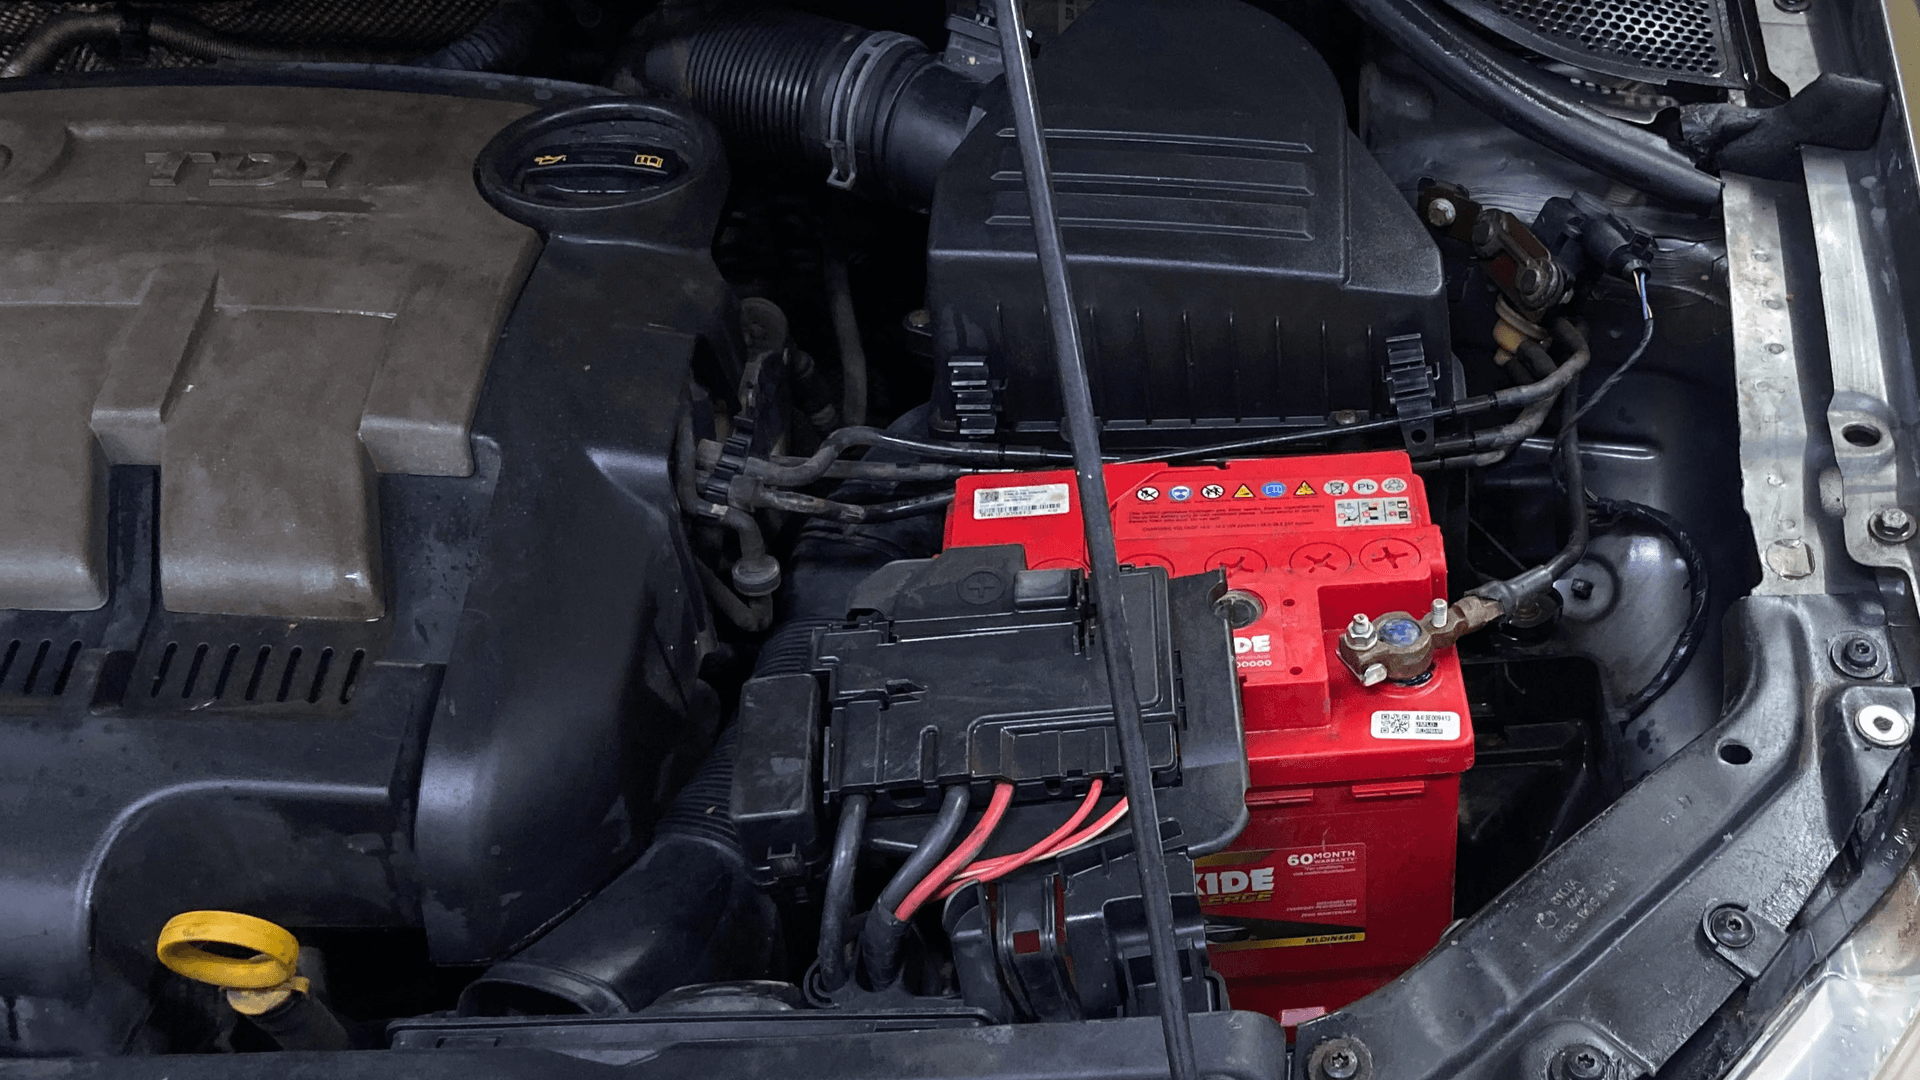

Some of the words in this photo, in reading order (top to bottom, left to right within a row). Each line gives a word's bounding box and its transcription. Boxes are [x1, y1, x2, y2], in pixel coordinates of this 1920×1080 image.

[145, 151, 349, 189] TDI
[1357, 482, 1375, 491] Pb
[1287, 853, 1313, 866] 60
[1313, 850, 1356, 859] MONTH
[1305, 934, 1356, 943] MLDIN44R
